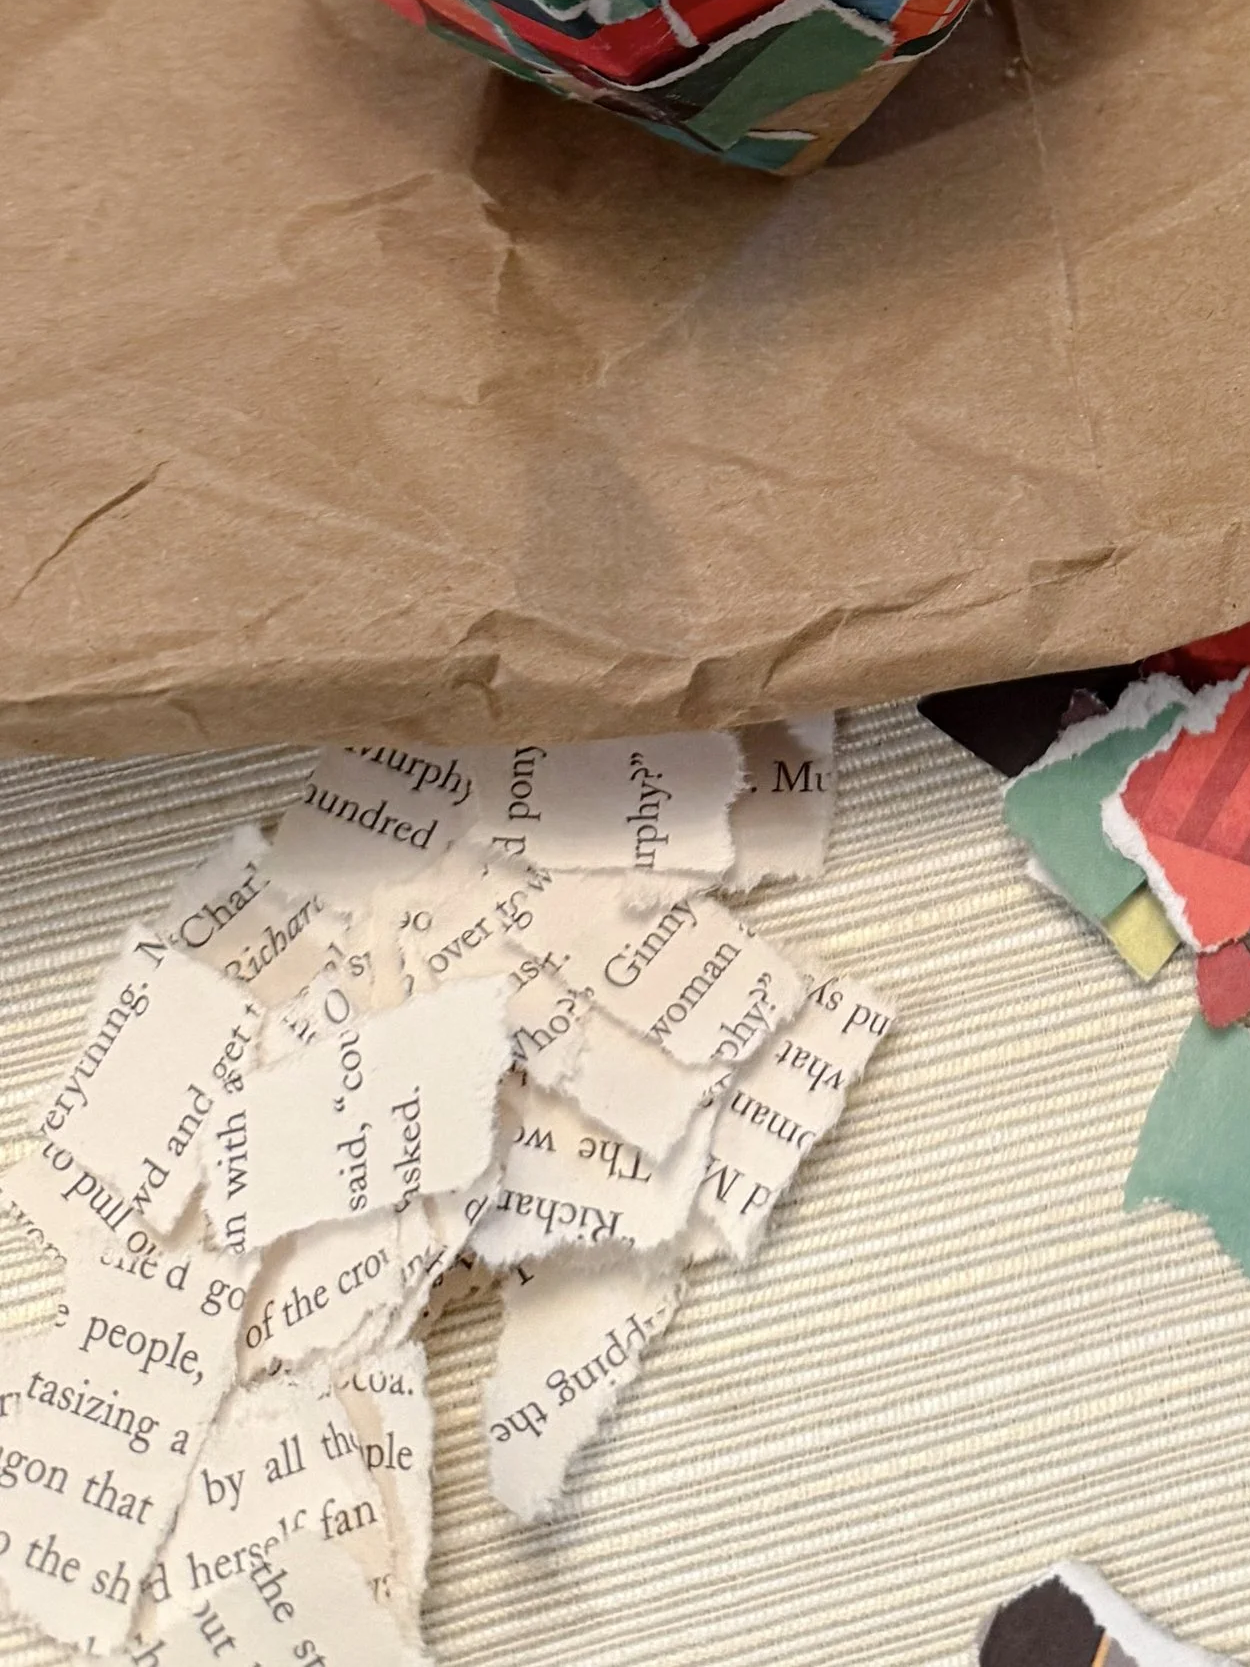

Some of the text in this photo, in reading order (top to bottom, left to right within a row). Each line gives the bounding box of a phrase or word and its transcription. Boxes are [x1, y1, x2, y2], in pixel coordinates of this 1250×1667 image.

[428, 916, 494, 973] over
[603, 896, 699, 989] Ginny
[168, 1084, 214, 1157] and
[217, 1109, 248, 1200] with
[336, 1122, 373, 1212] said,
[578, 1136, 652, 1187] The
[61, 1171, 136, 1232] pull
[245, 1299, 275, 1349] of
[282, 1285, 331, 1328] the
[78, 1315, 204, 1386] people,
[27, 1370, 160, 1455] tasizing
[490, 1401, 549, 1443] the
[82, 1469, 155, 1525] that
[200, 1467, 246, 1511] by
[264, 1433, 306, 1484] all
[319, 1497, 379, 1541] fan
[24, 1533, 81, 1583] the
[249, 1560, 296, 1623] the
